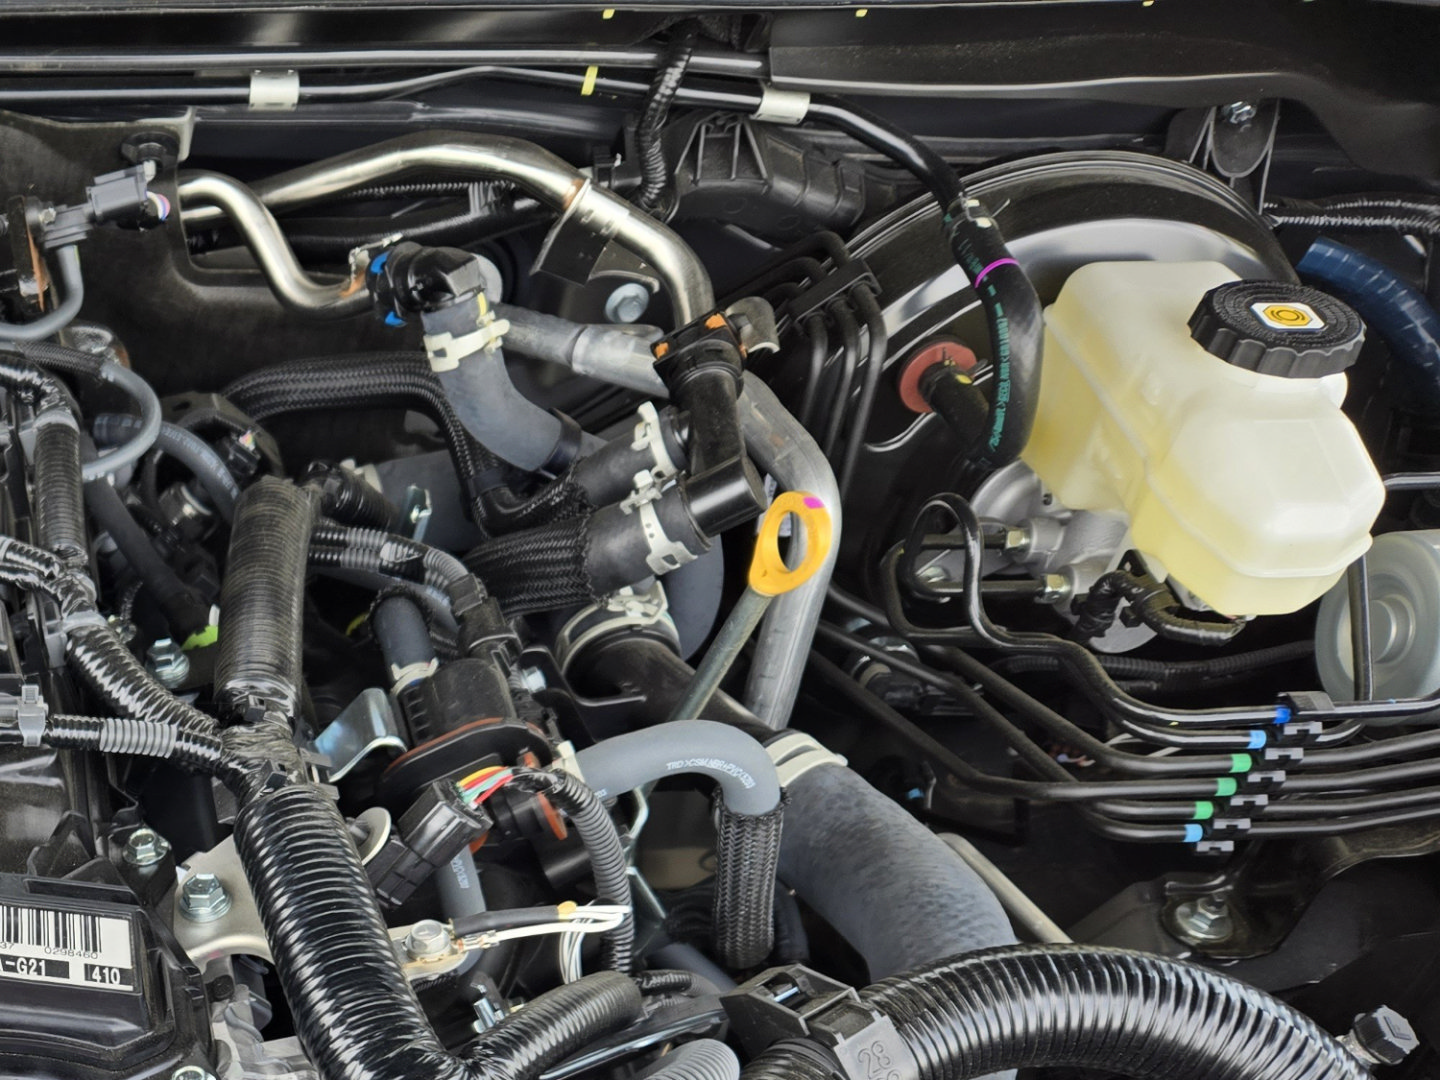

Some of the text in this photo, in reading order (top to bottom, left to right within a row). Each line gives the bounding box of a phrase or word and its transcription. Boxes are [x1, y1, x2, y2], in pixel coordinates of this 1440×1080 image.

[44, 946, 99, 960] 0298460
[91, 967, 121, 985] 410
[855, 1038, 896, 1080] 28
